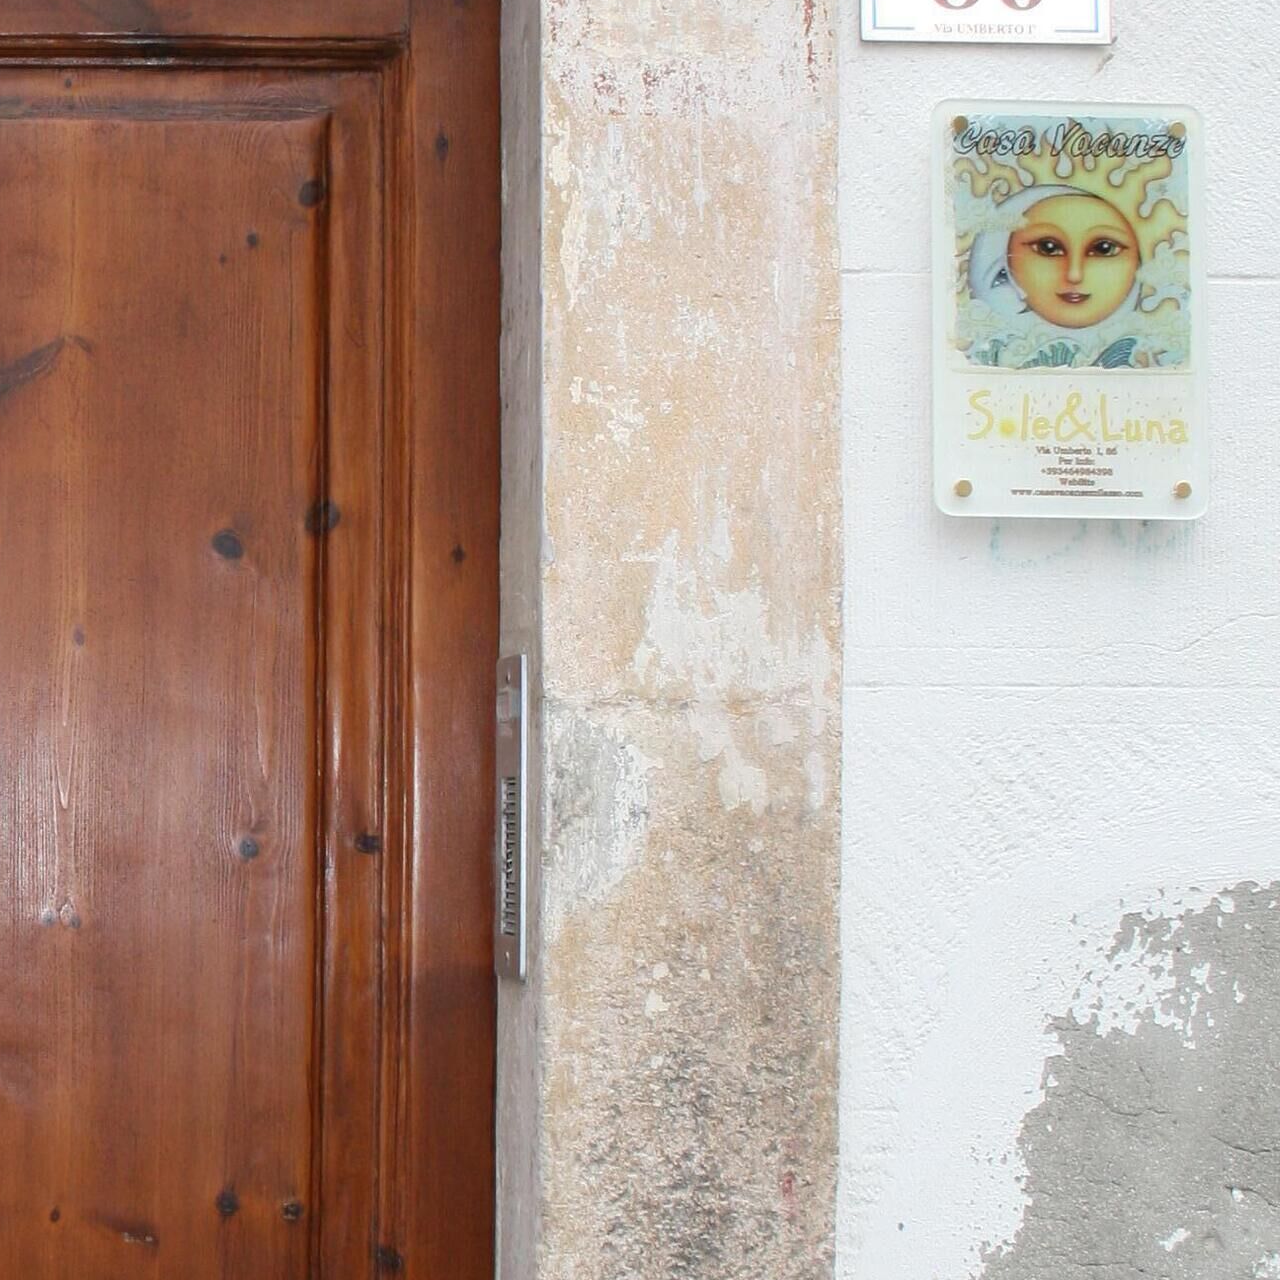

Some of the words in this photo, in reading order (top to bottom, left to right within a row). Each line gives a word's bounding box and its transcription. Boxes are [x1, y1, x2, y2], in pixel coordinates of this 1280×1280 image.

[957, 24, 1024, 35] UMBERTO
[953, 121, 1036, 155] Casa
[1051, 122, 1185, 158] Vacanze
[1035, 446, 1051, 455] Via
[1053, 446, 1092, 455] Umberto
